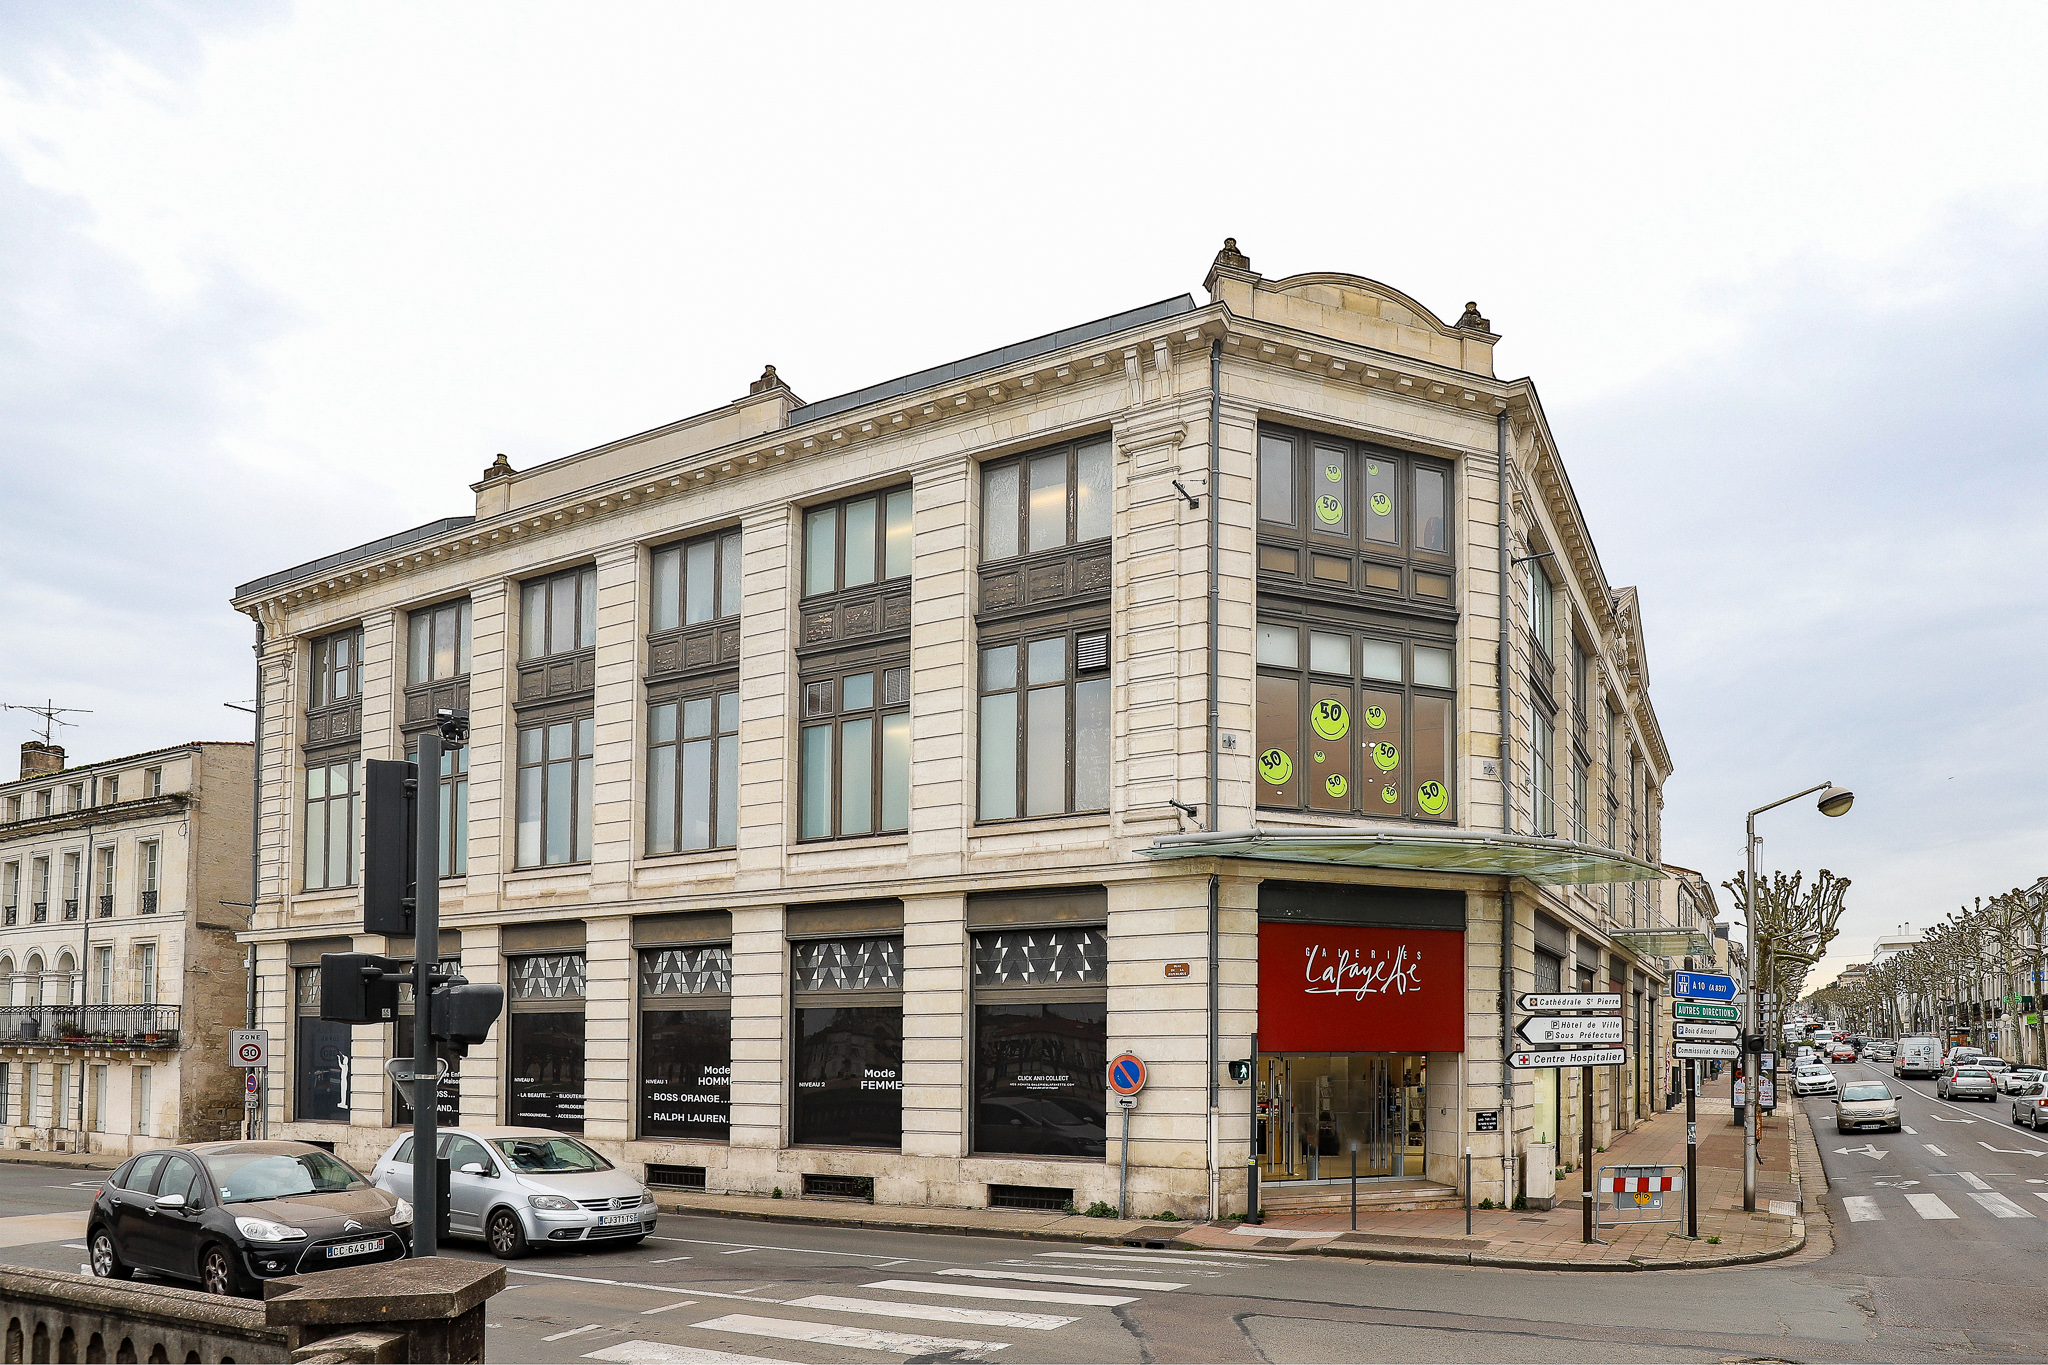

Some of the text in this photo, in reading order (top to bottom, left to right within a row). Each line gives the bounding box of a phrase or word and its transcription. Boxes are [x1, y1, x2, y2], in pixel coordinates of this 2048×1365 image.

[1327, 466, 1338, 475] 50
[1322, 496, 1339, 512] 50
[1373, 494, 1386, 505] 50
[1320, 701, 1342, 722] 50
[1369, 707, 1381, 718] 50
[1380, 743, 1396, 759] 50
[1261, 750, 1282, 770] 50
[1328, 775, 1341, 787] 50
[1386, 786, 1396, 797] 50
[1421, 782, 1439, 800] 50
[1305, 946, 1422, 960] GALERIES
[1304, 944, 1422, 1001] Lafayette
[1539, 998, 1582, 1006] Cathédrale
[1678, 1005, 1735, 1018] AUTRES DIRECTIONS
[1561, 1021, 1582, 1029] Hôtel
[1579, 1031, 1620, 1039] Préfecture
[1685, 1027, 1695, 1035] Bois
[243, 1048, 257, 1057] 30
[1677, 1046, 1735, 1056] Commissariat de Police
[1534, 1052, 1622, 1065] Centre Hospitalier
[704, 1065, 731, 1075] Mode
[864, 1068, 896, 1078] Mode
[860, 1080, 903, 1090] FEMME
[653, 1092, 679, 1102] BOSS
[653, 1112, 685, 1122] RALPH
